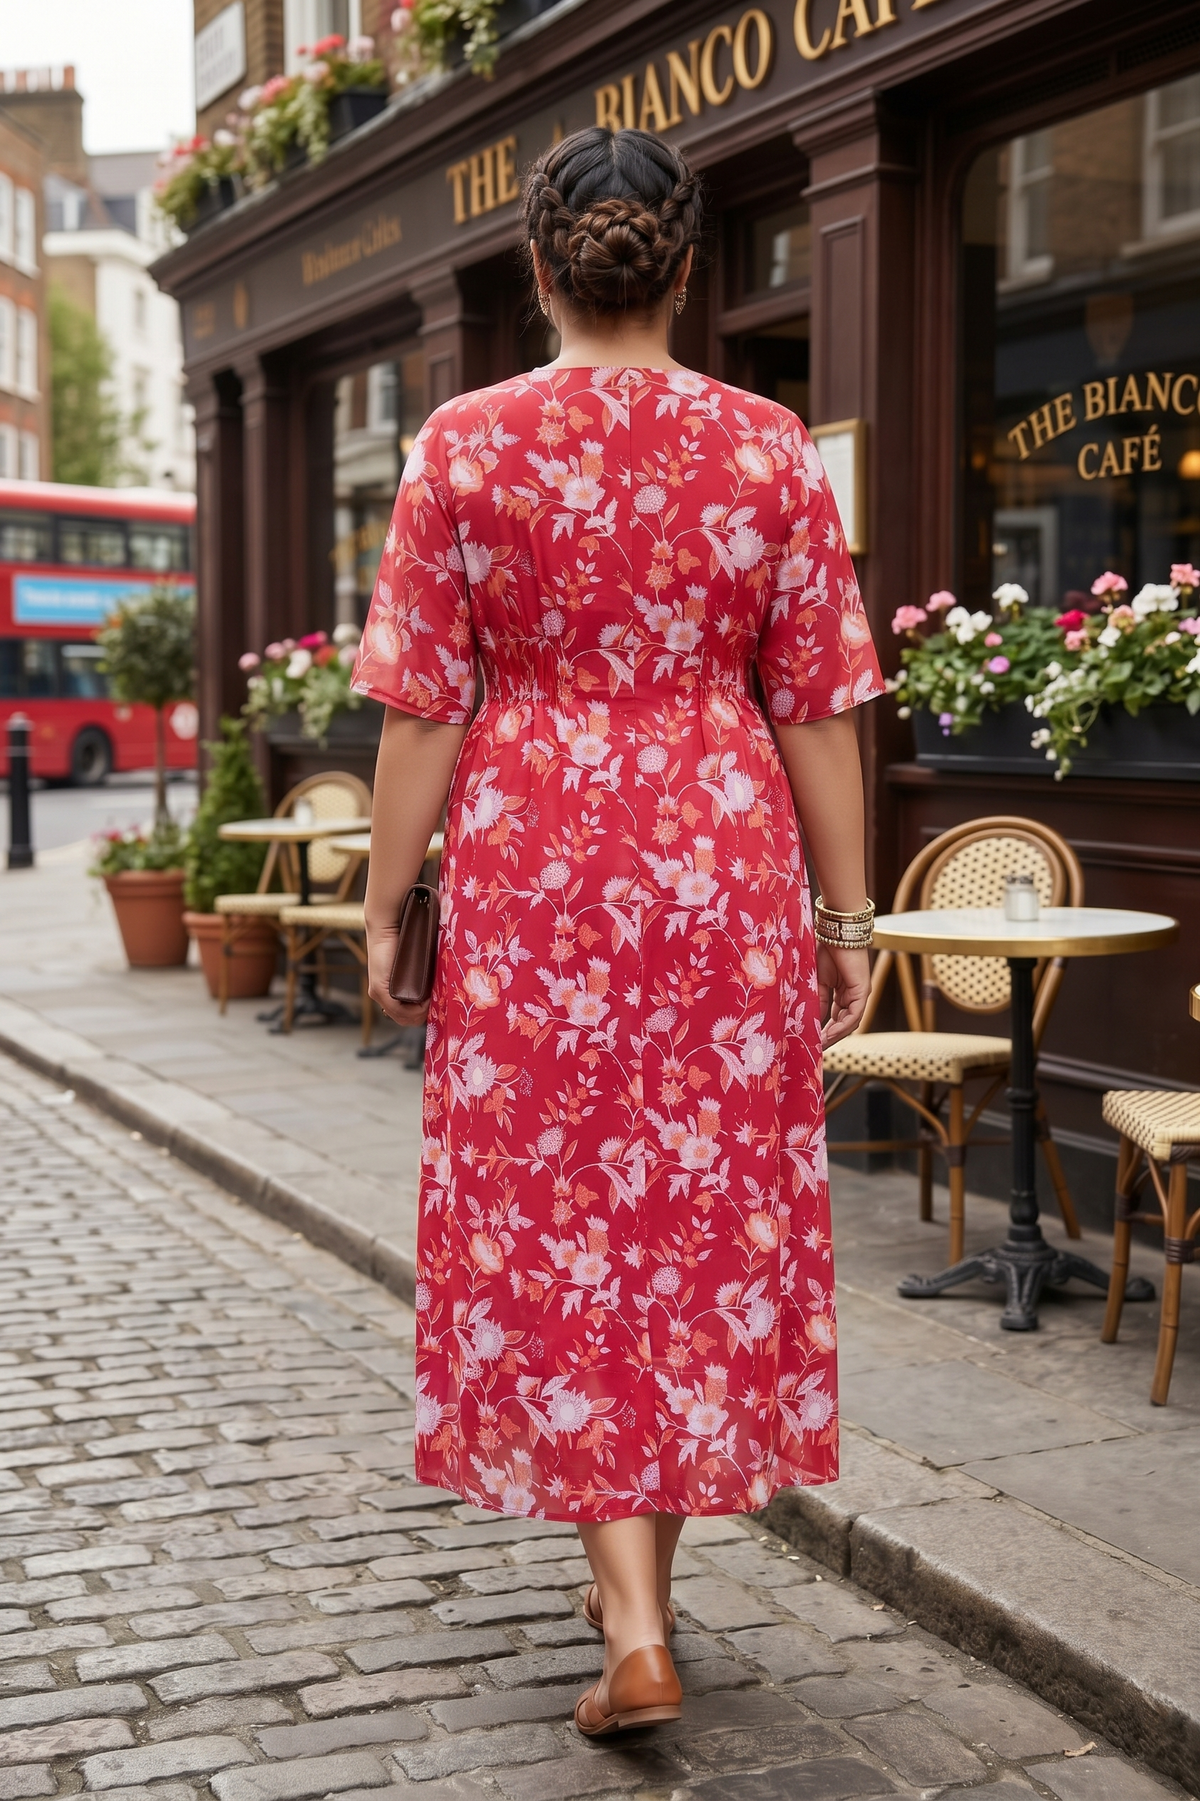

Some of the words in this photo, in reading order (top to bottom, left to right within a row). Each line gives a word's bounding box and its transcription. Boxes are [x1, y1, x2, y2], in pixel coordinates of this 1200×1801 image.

[446, 135, 520, 225] THE
[594, 8, 771, 134] BIANCO
[1007, 392, 1077, 461] THE
[1082, 371, 1200, 421] BIANC
[1077, 424, 1162, 480] CAFÉ
